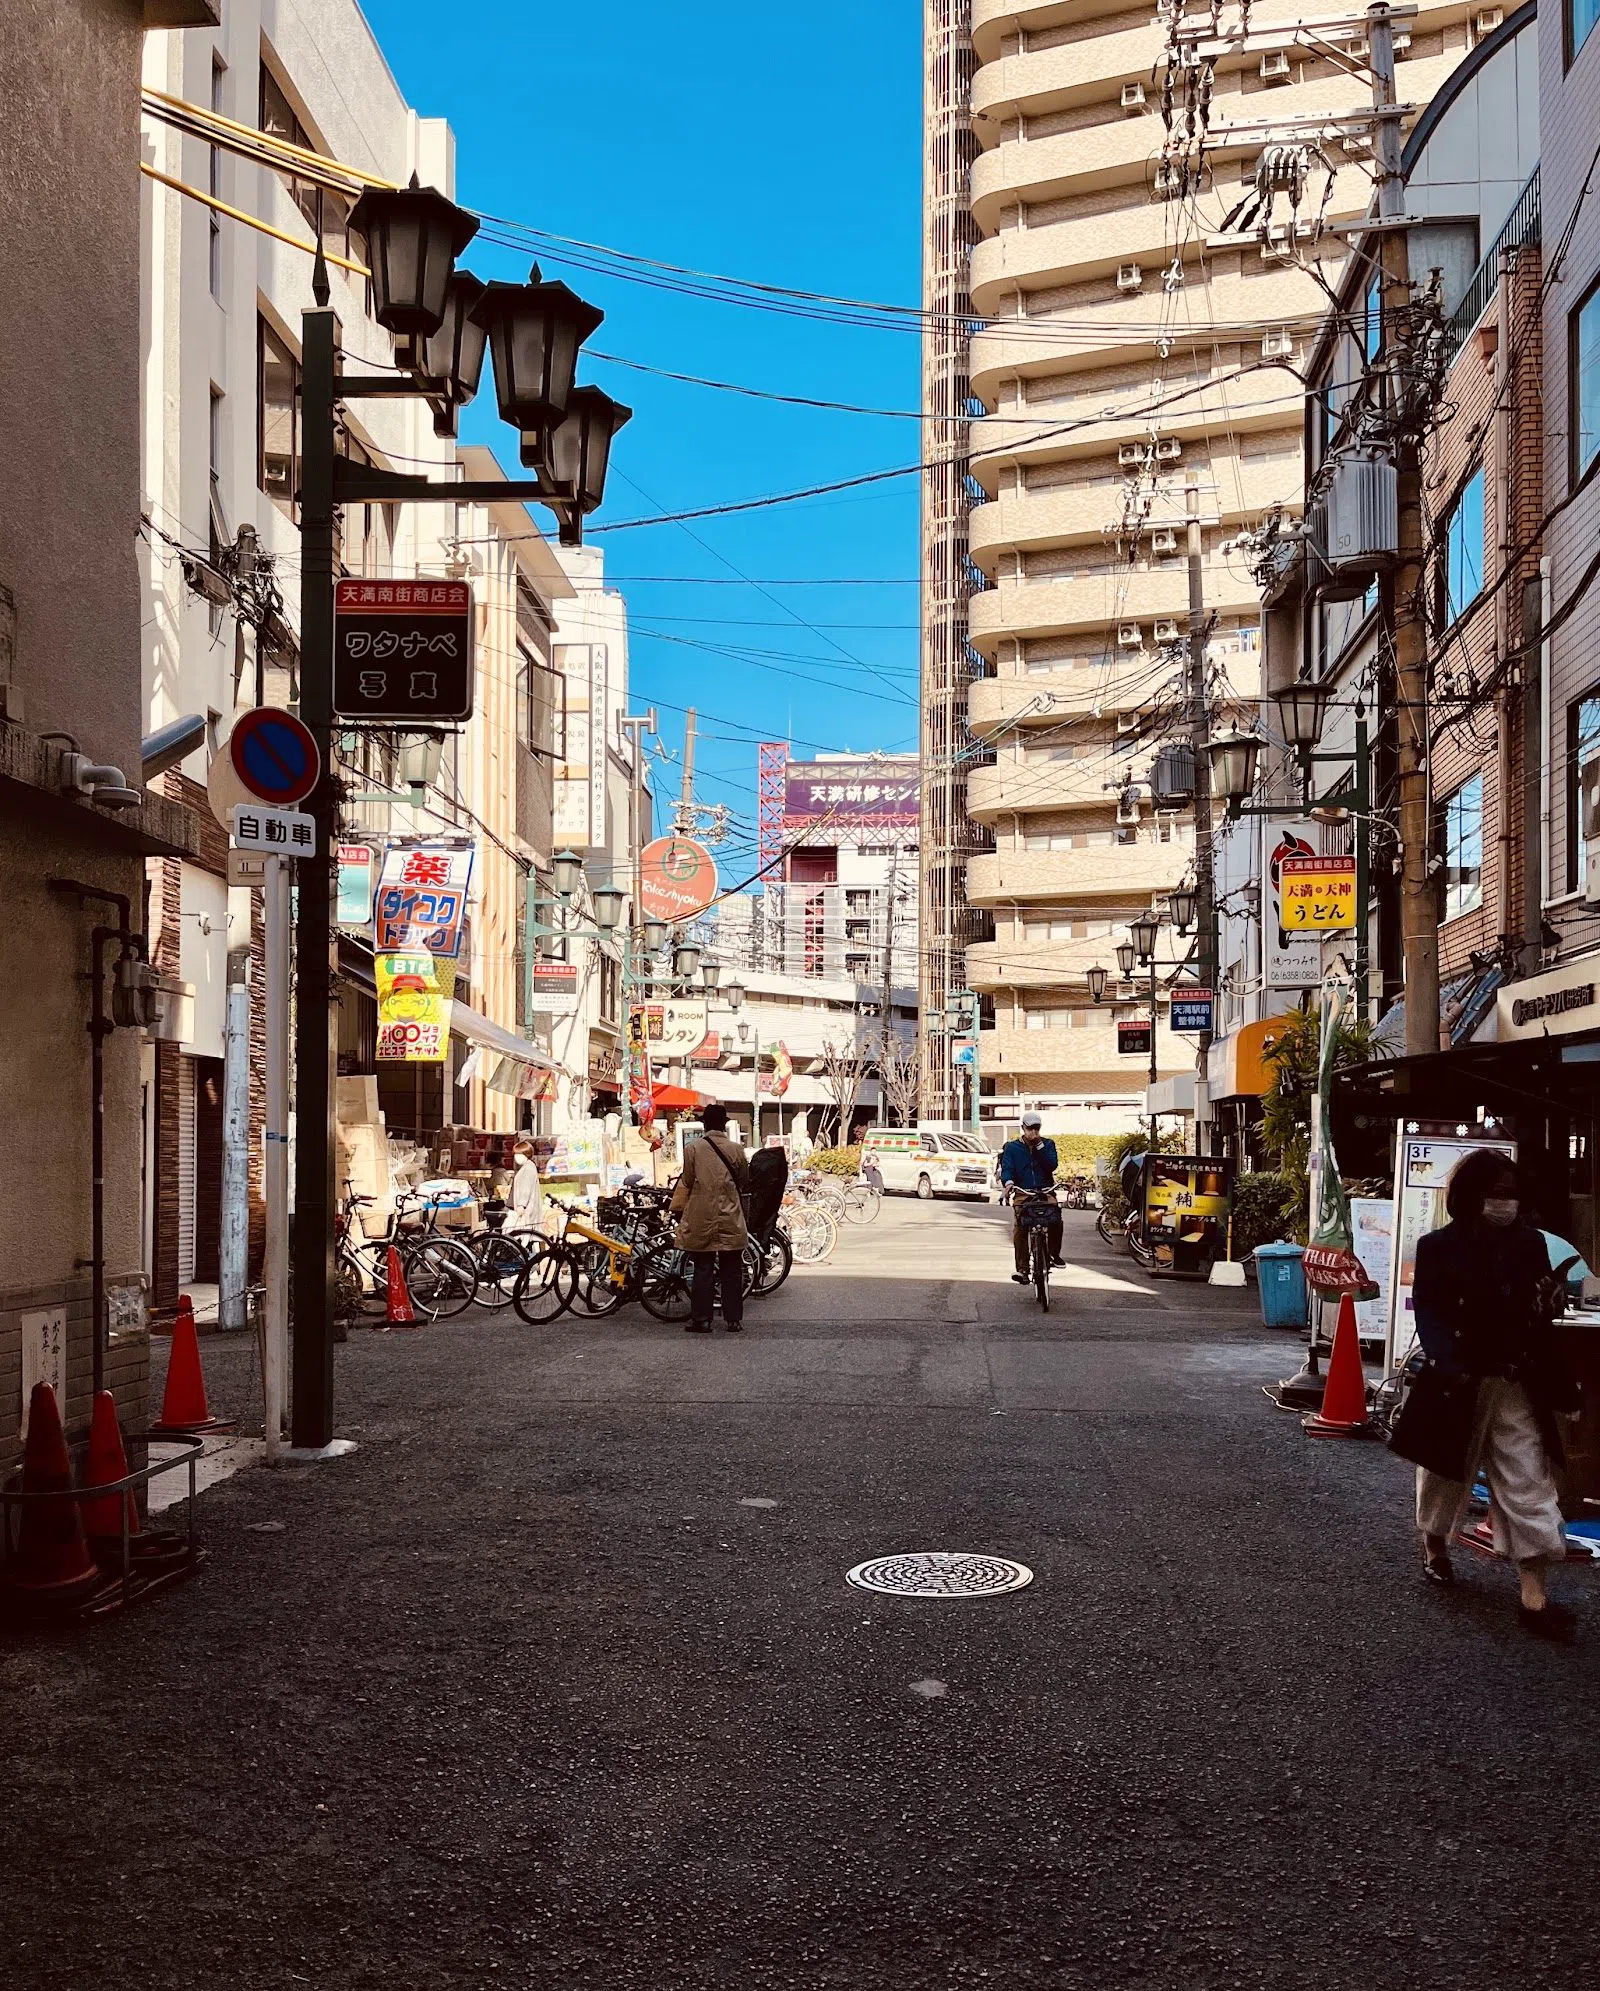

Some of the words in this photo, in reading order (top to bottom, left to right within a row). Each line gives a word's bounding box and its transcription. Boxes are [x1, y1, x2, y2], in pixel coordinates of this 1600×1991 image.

[342, 586, 465, 603] 天満南街商店会
[345, 630, 458, 658] ワタナベ
[359, 671, 437, 699] 写真
[240, 815, 313, 847] 自動車
[402, 852, 453, 886] 薬
[1284, 859, 1354, 871] 天満南街商店会
[383, 889, 456, 925] ダイコク
[1294, 904, 1346, 922] うどん
[384, 922, 449, 947] ドラッグ
[1173, 1004, 1210, 1015] 天満駅前
[1178, 1016, 1206, 1026] 整骨院
